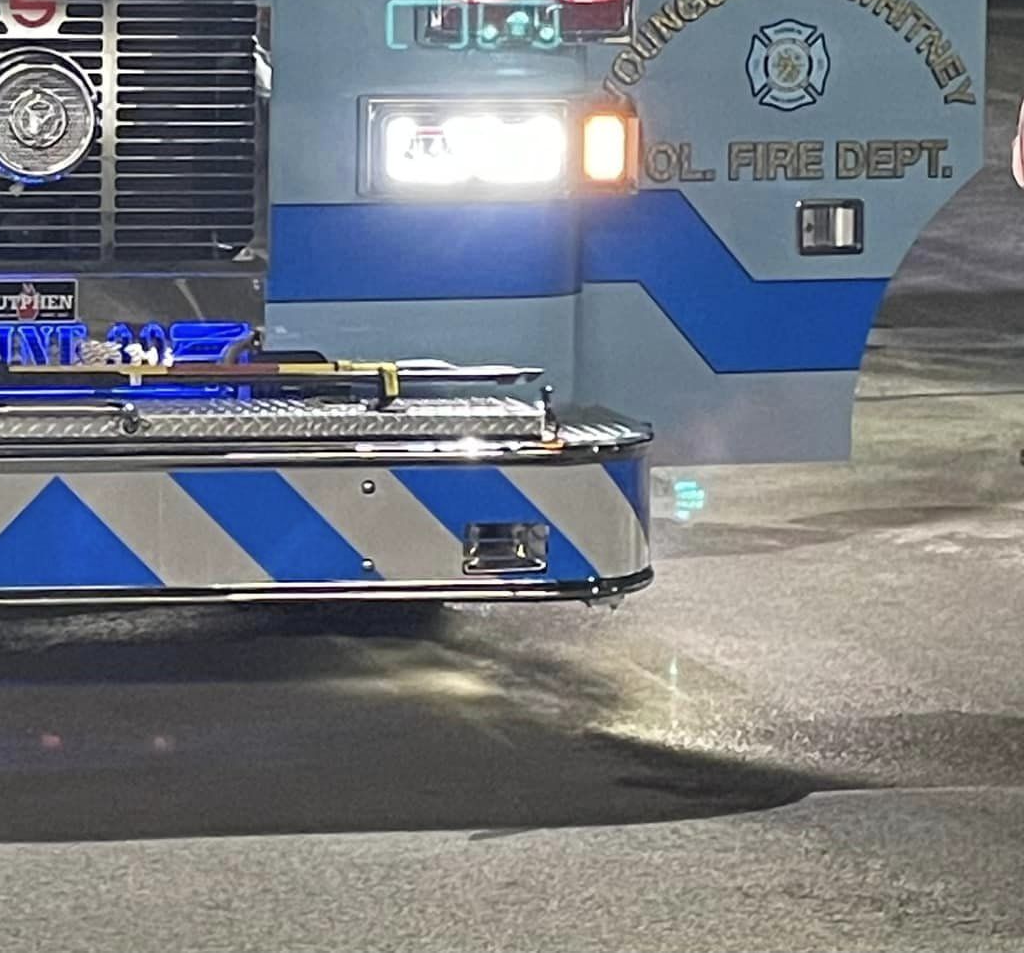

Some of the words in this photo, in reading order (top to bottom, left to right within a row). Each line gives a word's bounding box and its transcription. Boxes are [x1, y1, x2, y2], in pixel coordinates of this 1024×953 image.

[643, 140, 717, 183] OL.
[727, 140, 825, 181] FIRE
[835, 138, 954, 180] DEPT.
